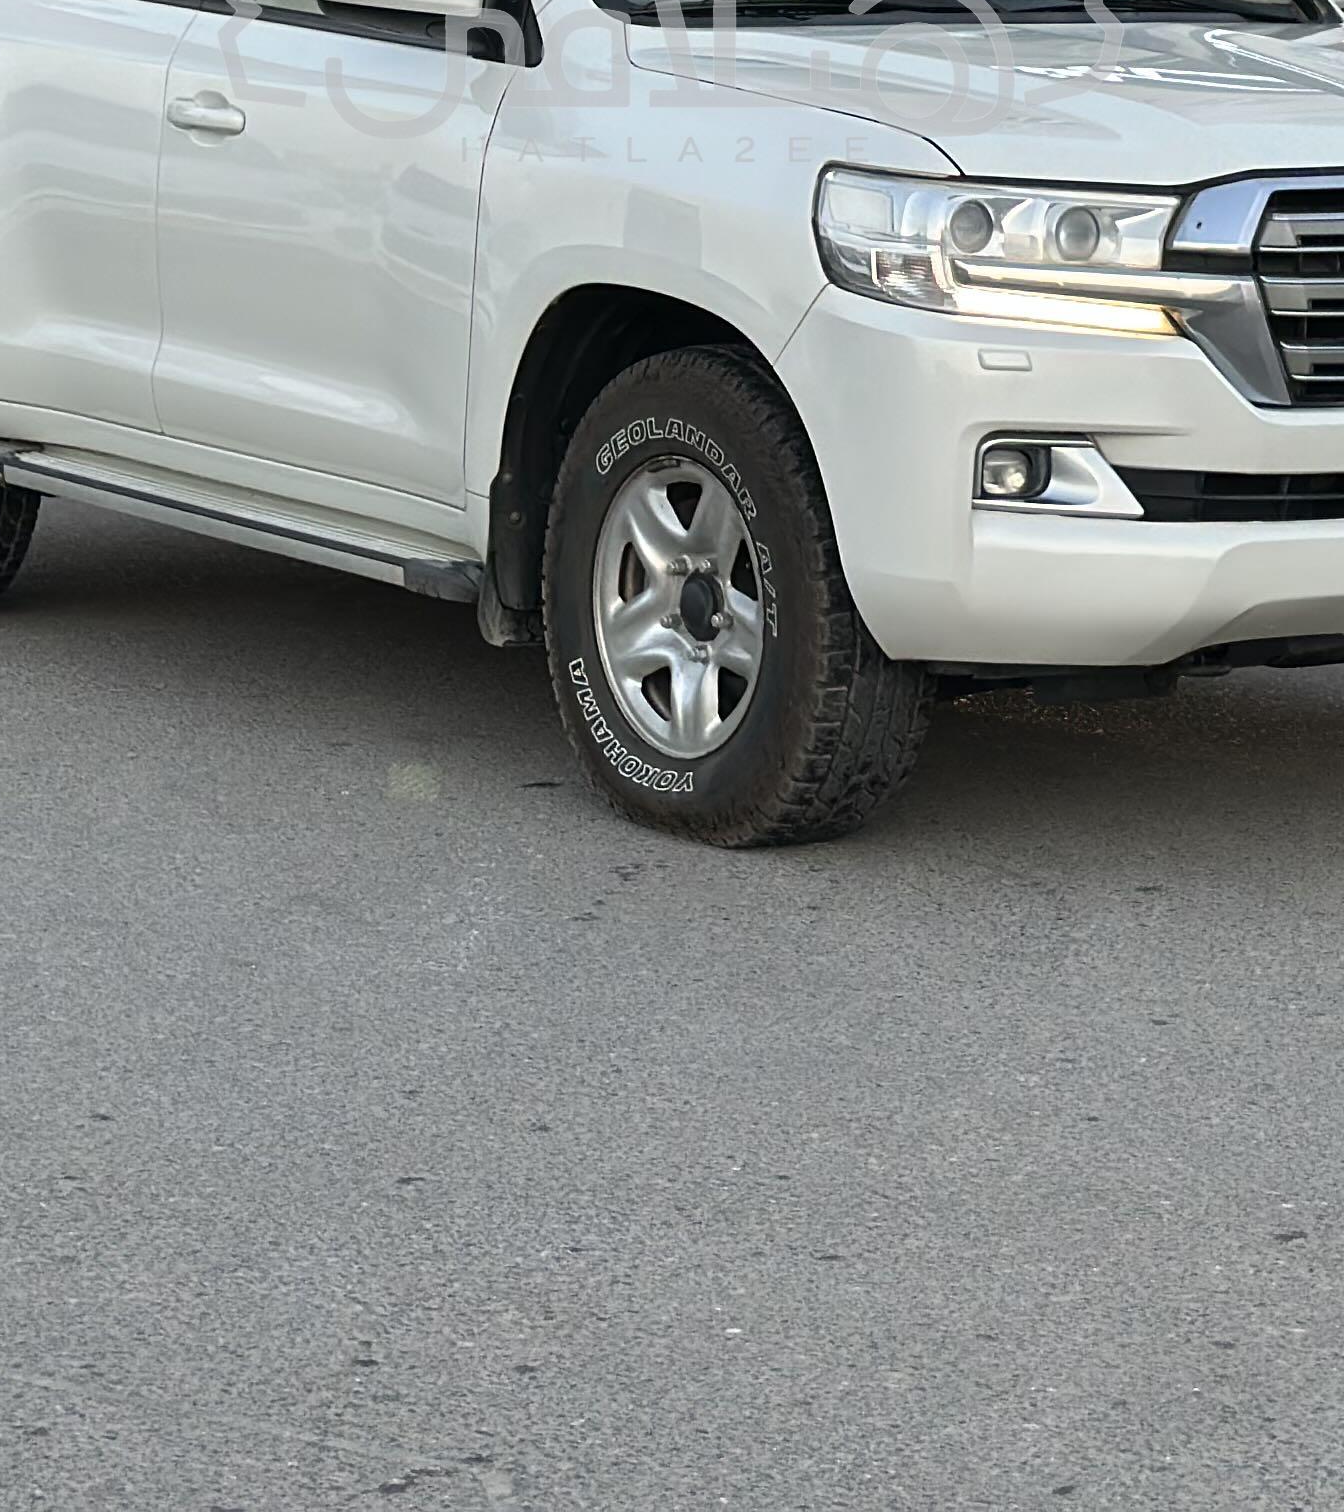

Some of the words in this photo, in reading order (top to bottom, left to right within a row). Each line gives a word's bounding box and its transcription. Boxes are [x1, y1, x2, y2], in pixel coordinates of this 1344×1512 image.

[595, 417, 757, 521] GEOLANDAR
[756, 541, 779, 638] A/T
[568, 657, 695, 793] YOKOHAMA
